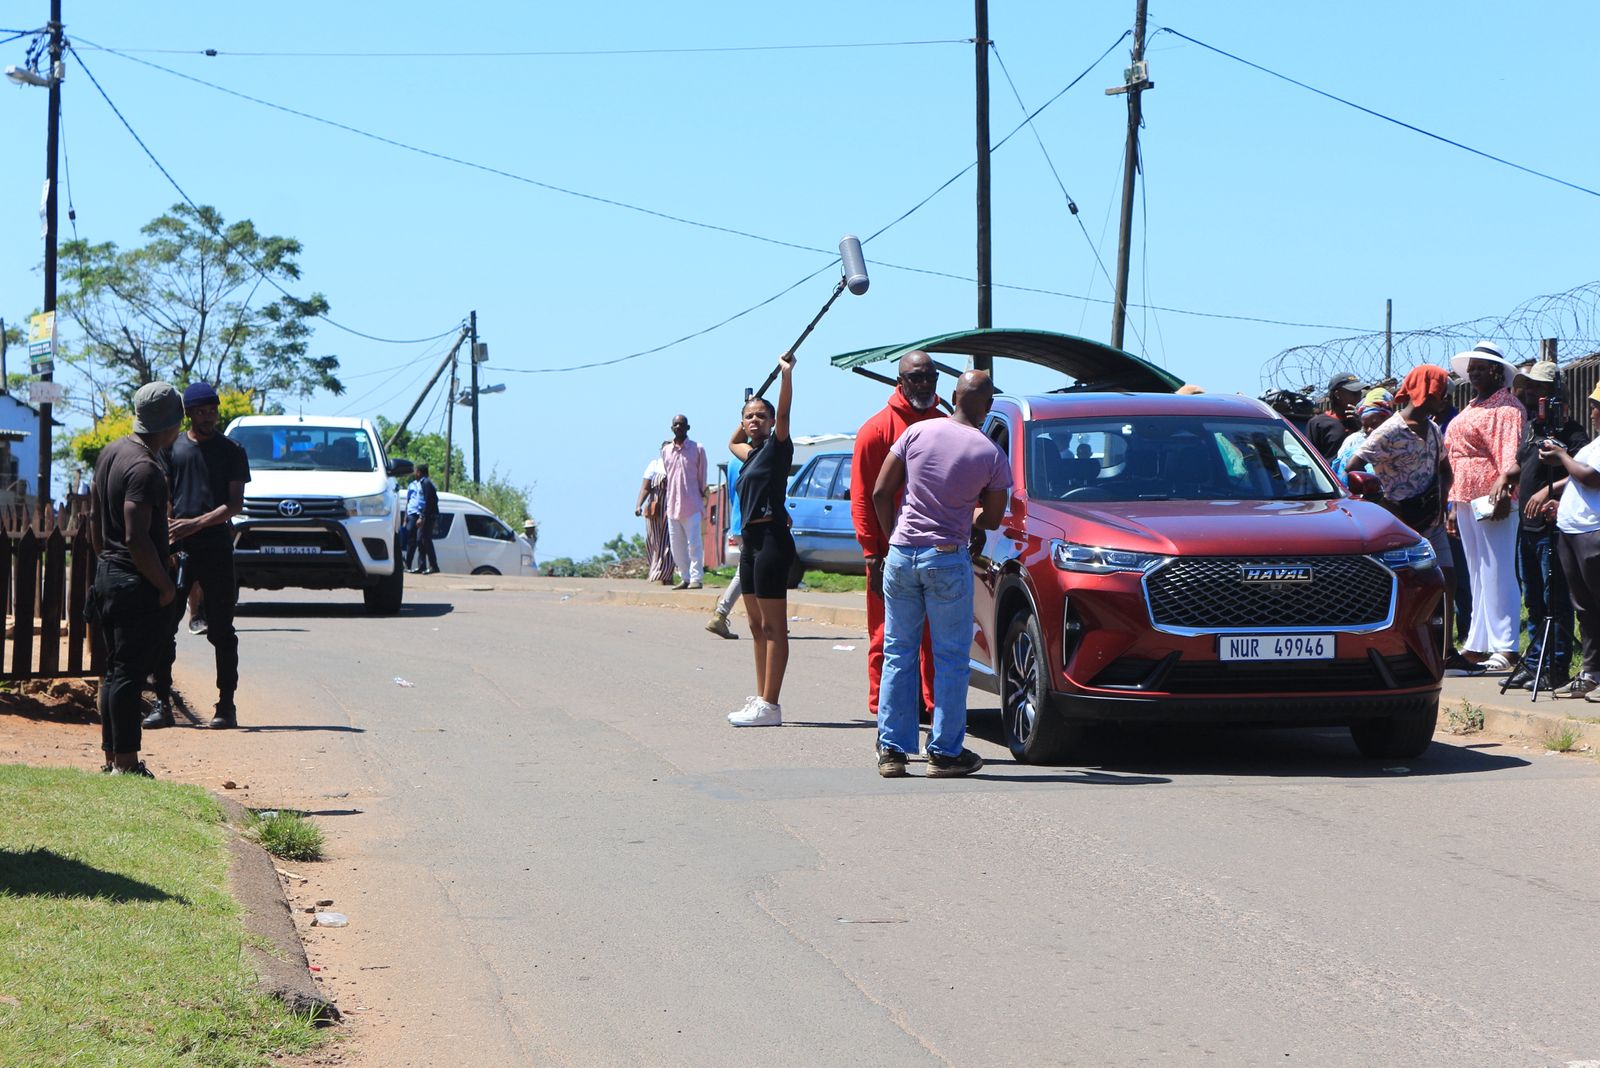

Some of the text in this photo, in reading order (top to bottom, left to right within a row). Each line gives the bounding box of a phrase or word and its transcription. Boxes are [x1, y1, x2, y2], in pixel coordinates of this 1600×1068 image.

[1247, 569, 1308, 580] HAVAL
[1230, 638, 1324, 658] NUR 49946
